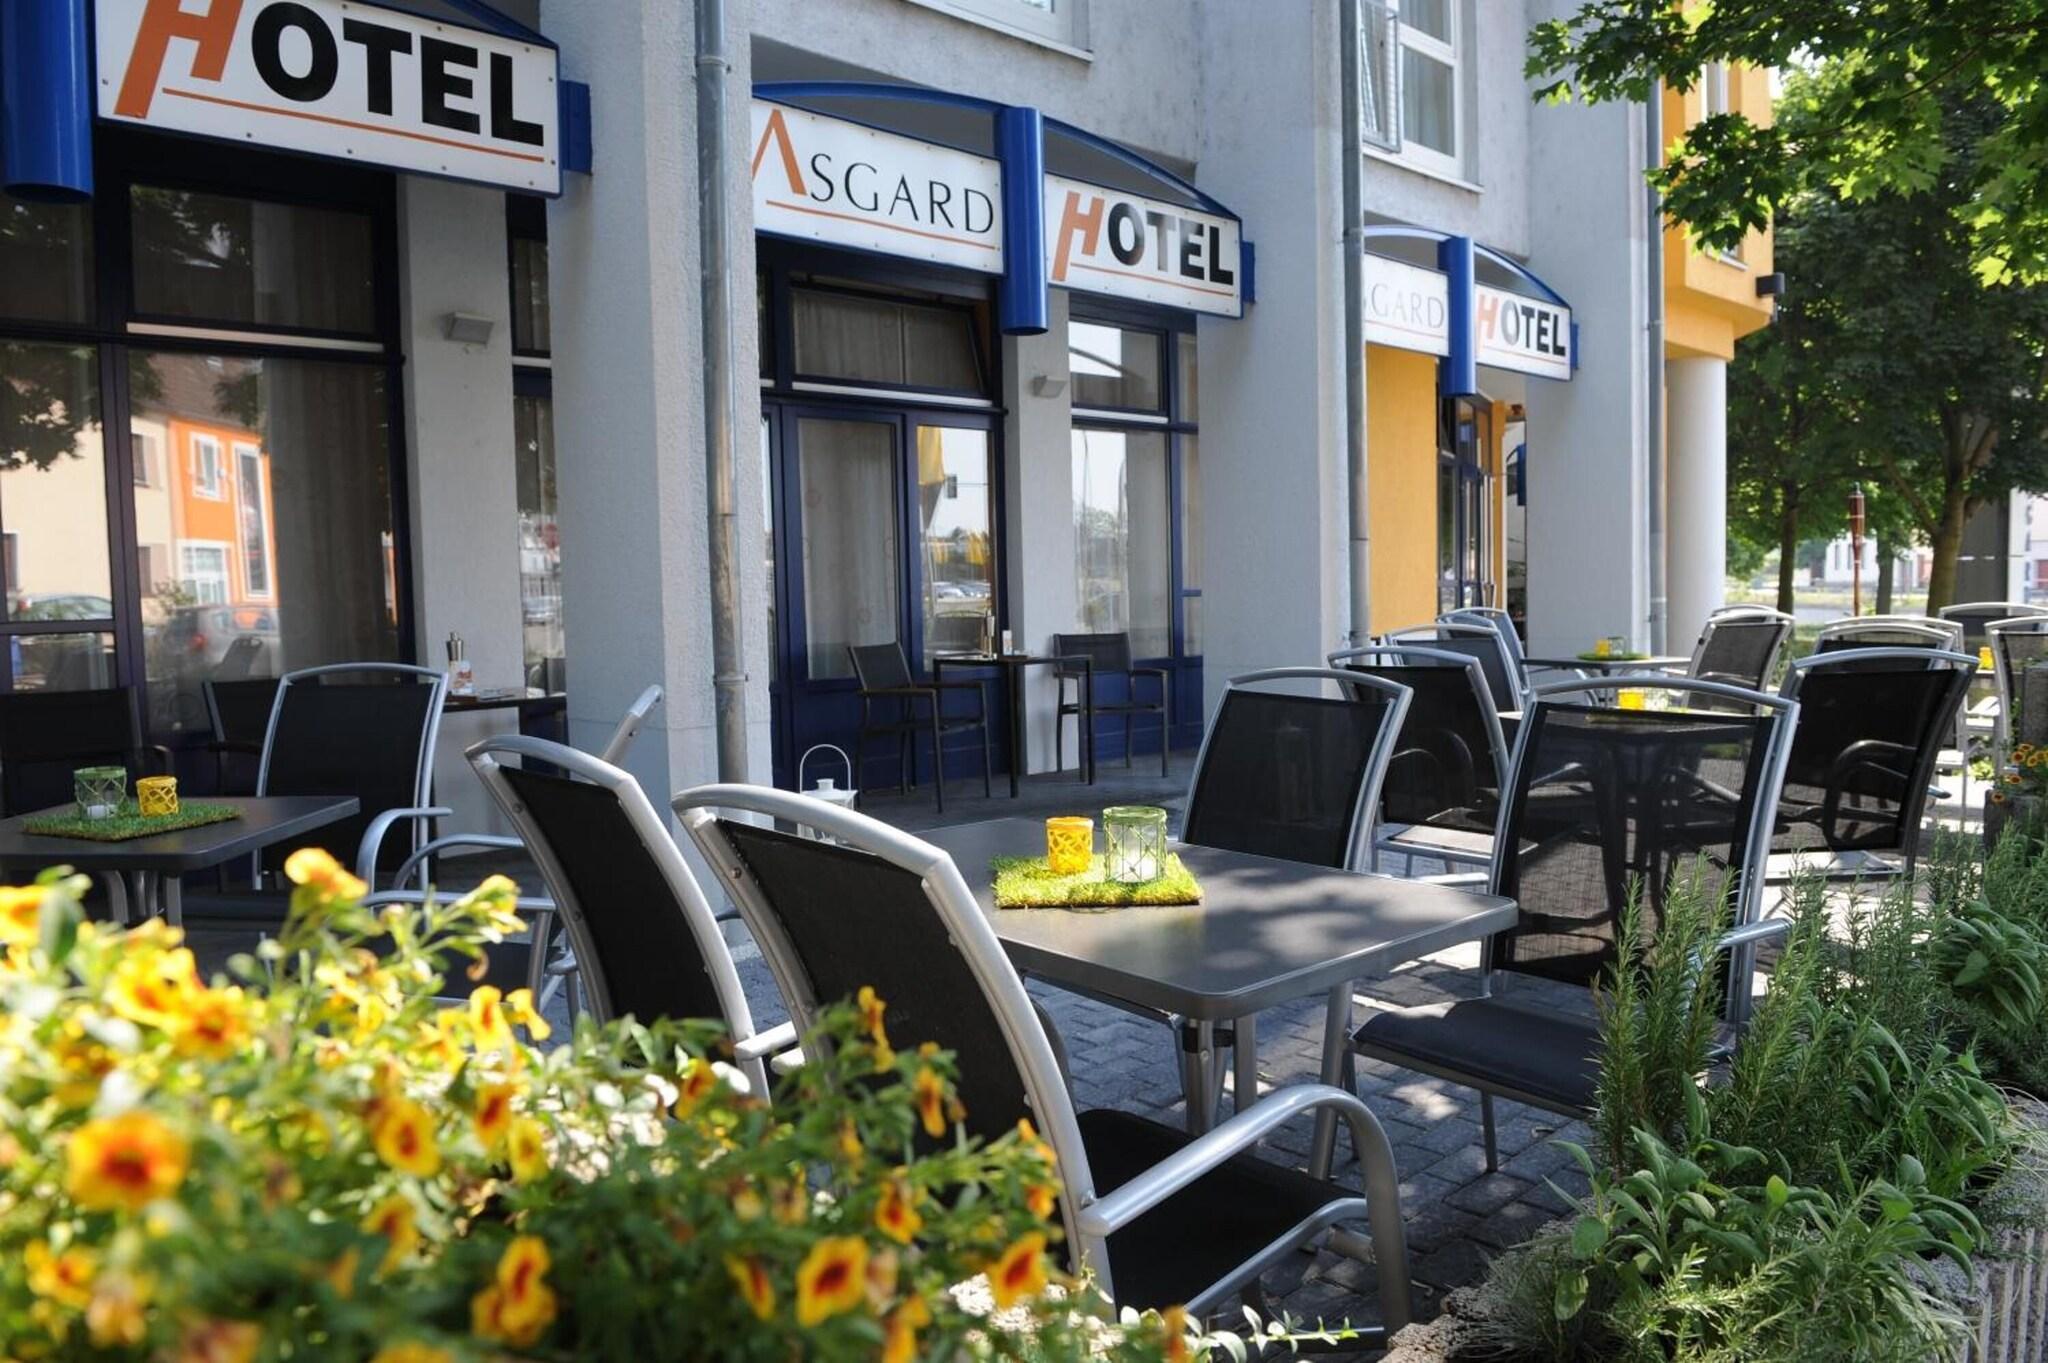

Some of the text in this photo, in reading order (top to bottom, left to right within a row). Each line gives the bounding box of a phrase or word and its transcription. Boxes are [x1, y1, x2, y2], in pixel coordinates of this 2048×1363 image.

[114, 0, 544, 147] HOTEL
[752, 108, 1234, 286] ASGARD HOTEL
[1362, 283, 1565, 356] GARD HOTEL
